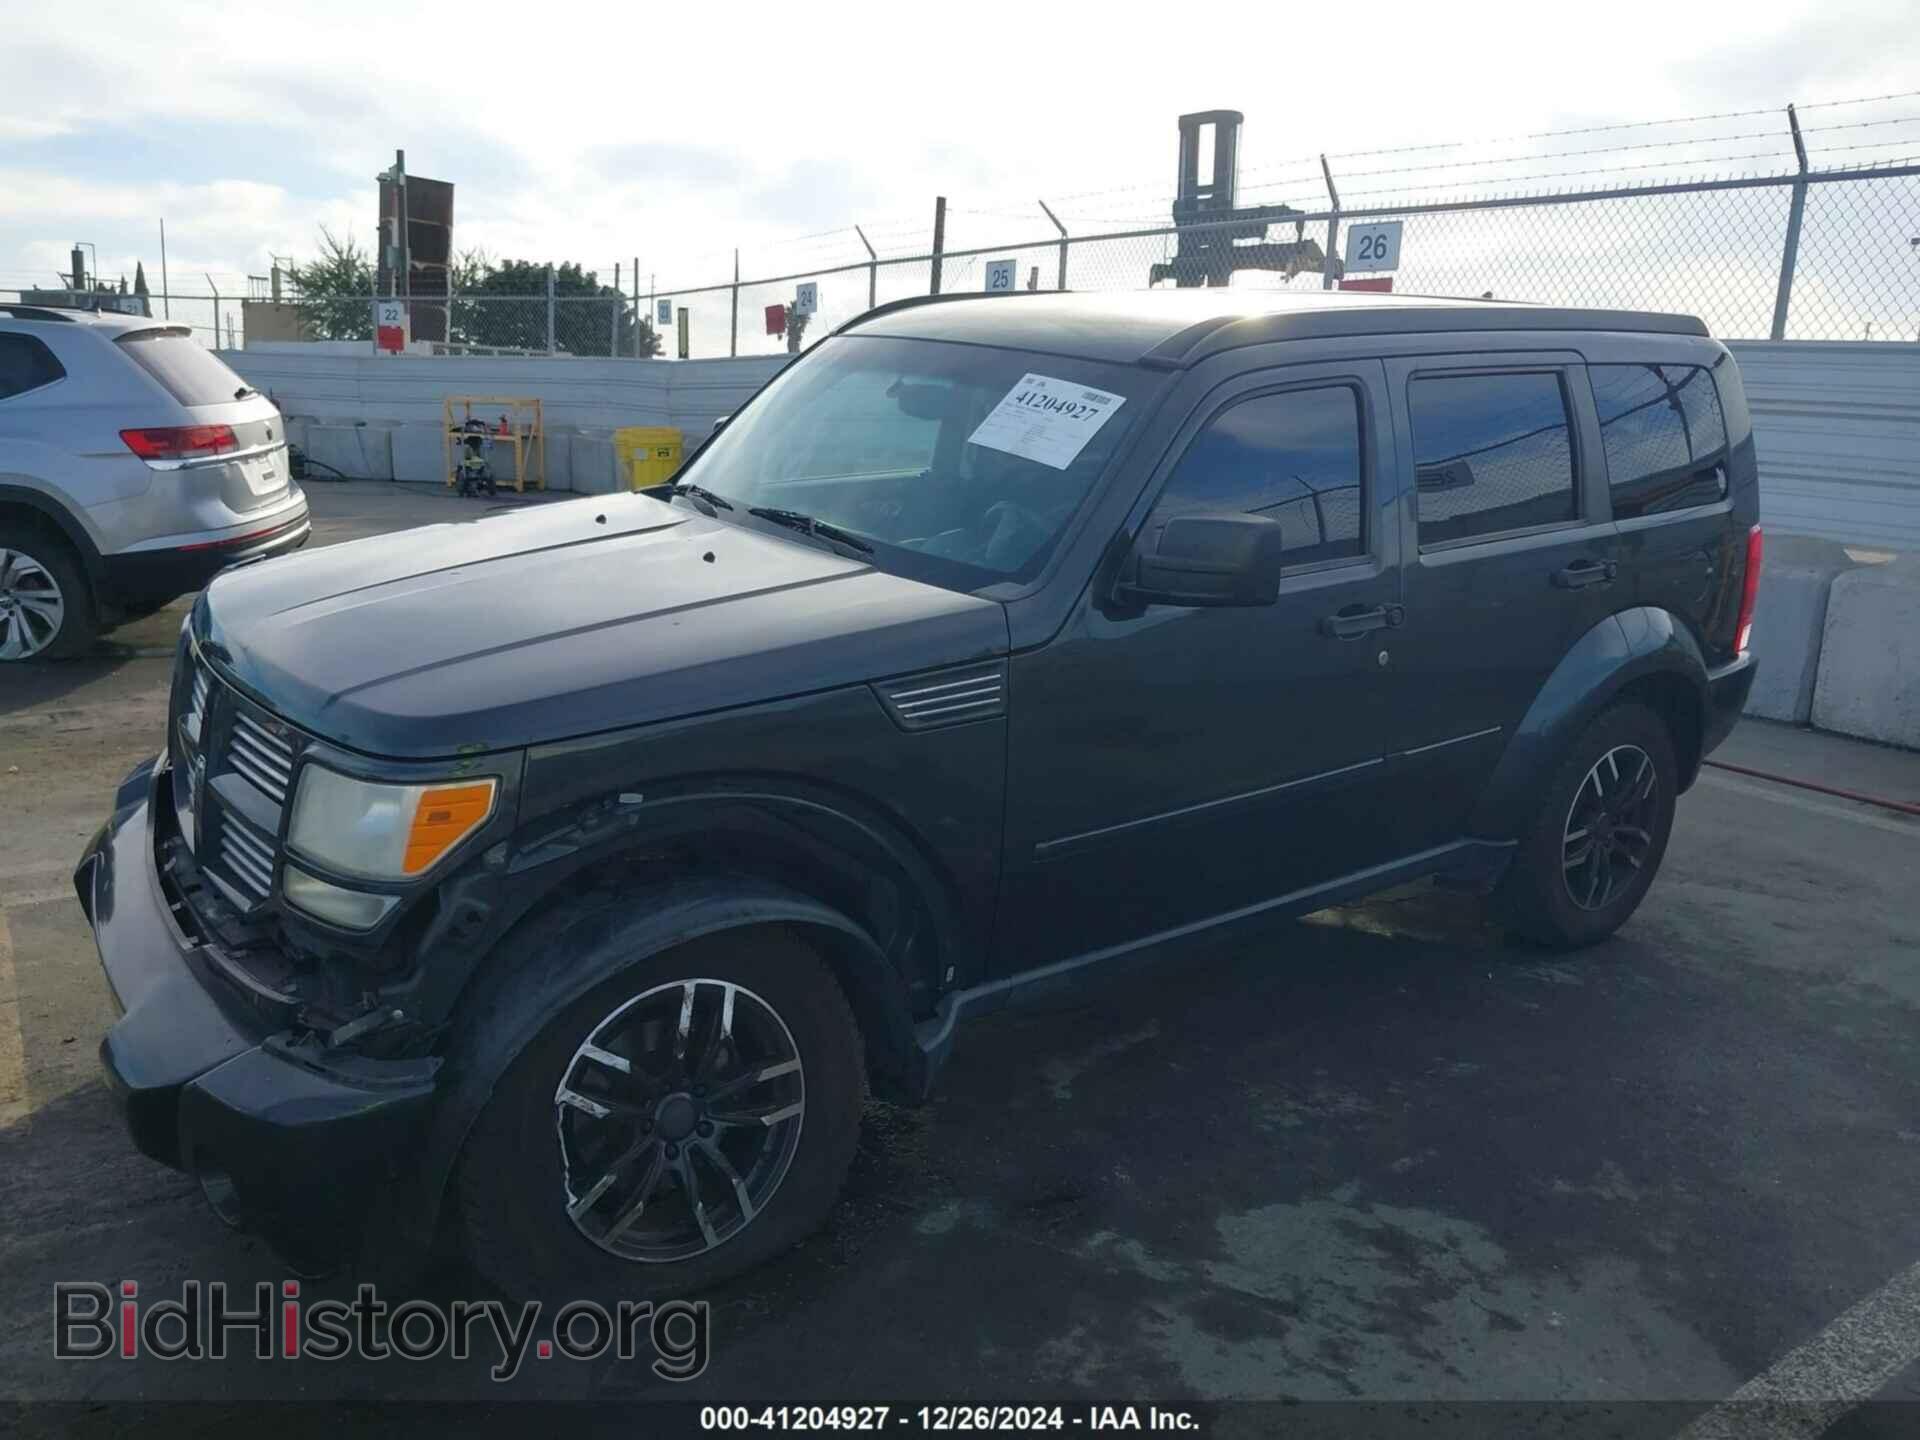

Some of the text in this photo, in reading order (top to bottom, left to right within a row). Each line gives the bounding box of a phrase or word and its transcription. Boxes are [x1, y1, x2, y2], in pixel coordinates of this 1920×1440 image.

[1358, 233, 1388, 260] 26
[992, 269, 1009, 288] 25
[801, 290, 814, 307] 24
[385, 309, 400, 321] 22
[1016, 391, 1099, 422] 41204927
